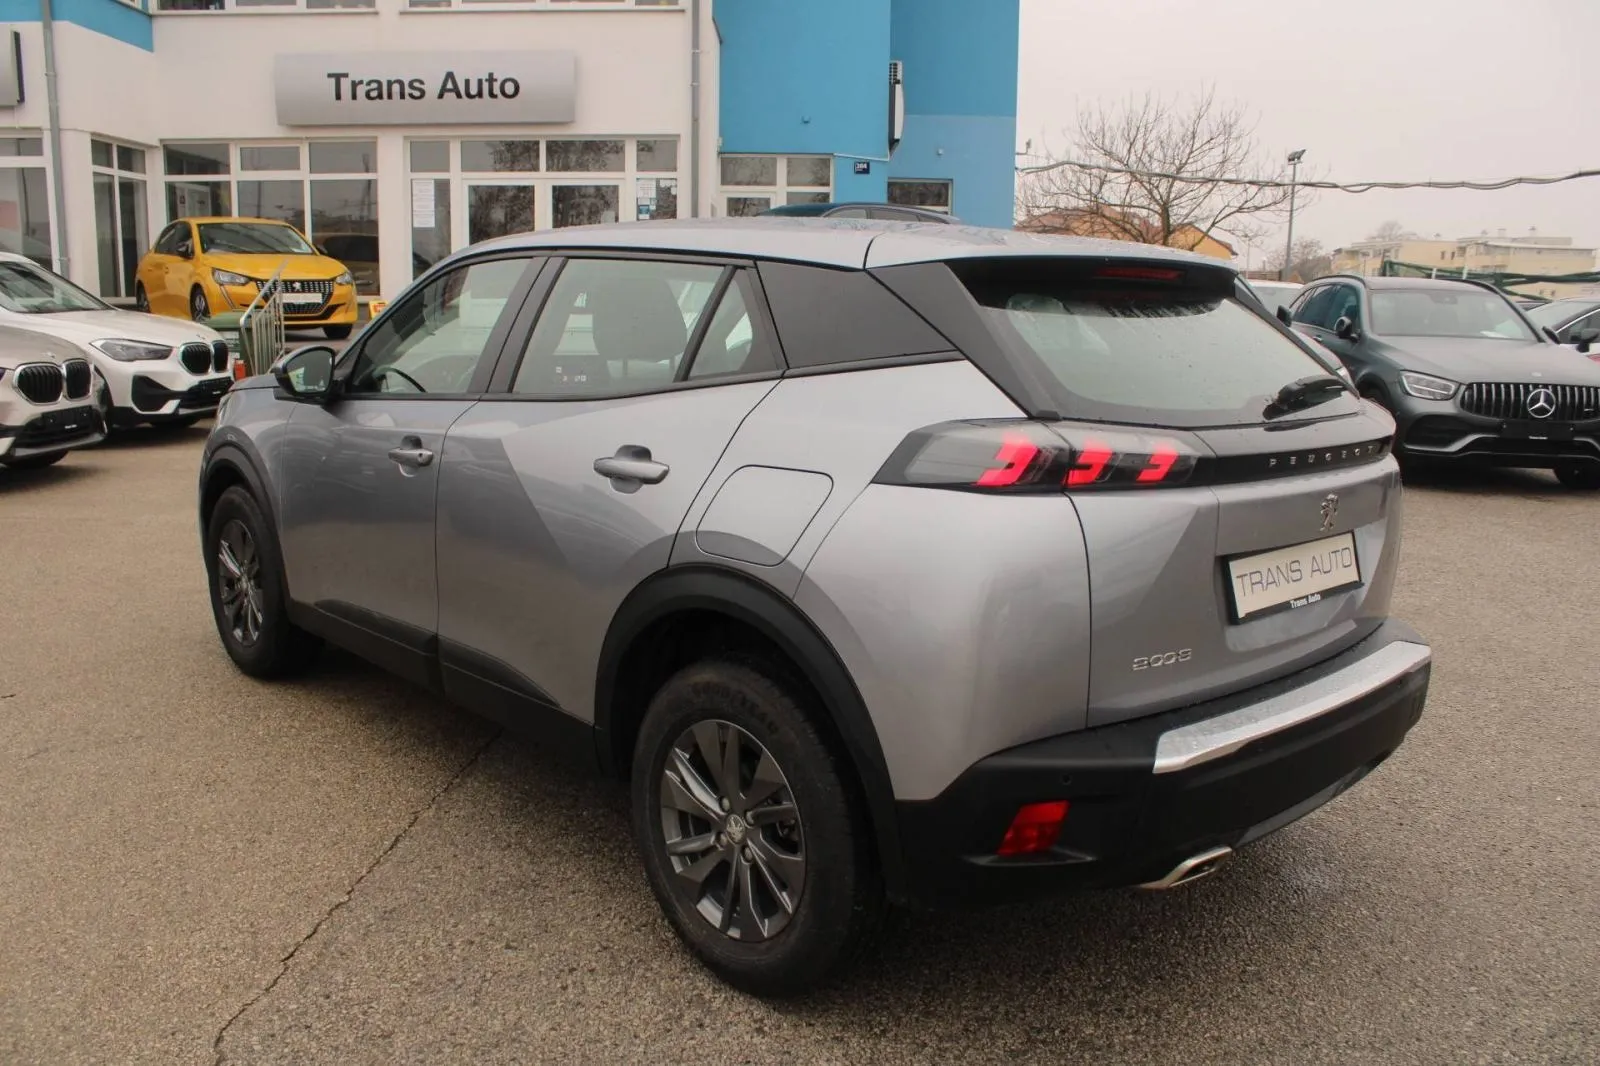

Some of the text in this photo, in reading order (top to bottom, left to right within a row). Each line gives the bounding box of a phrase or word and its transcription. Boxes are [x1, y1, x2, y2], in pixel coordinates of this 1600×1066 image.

[327, 71, 521, 101] Trans Auto
[1269, 445, 1374, 467] PEUGEOT
[1236, 546, 1353, 598] TRANS AUTO
[1290, 593, 1321, 609] Trans Auto
[1132, 648, 1192, 671] 2008
